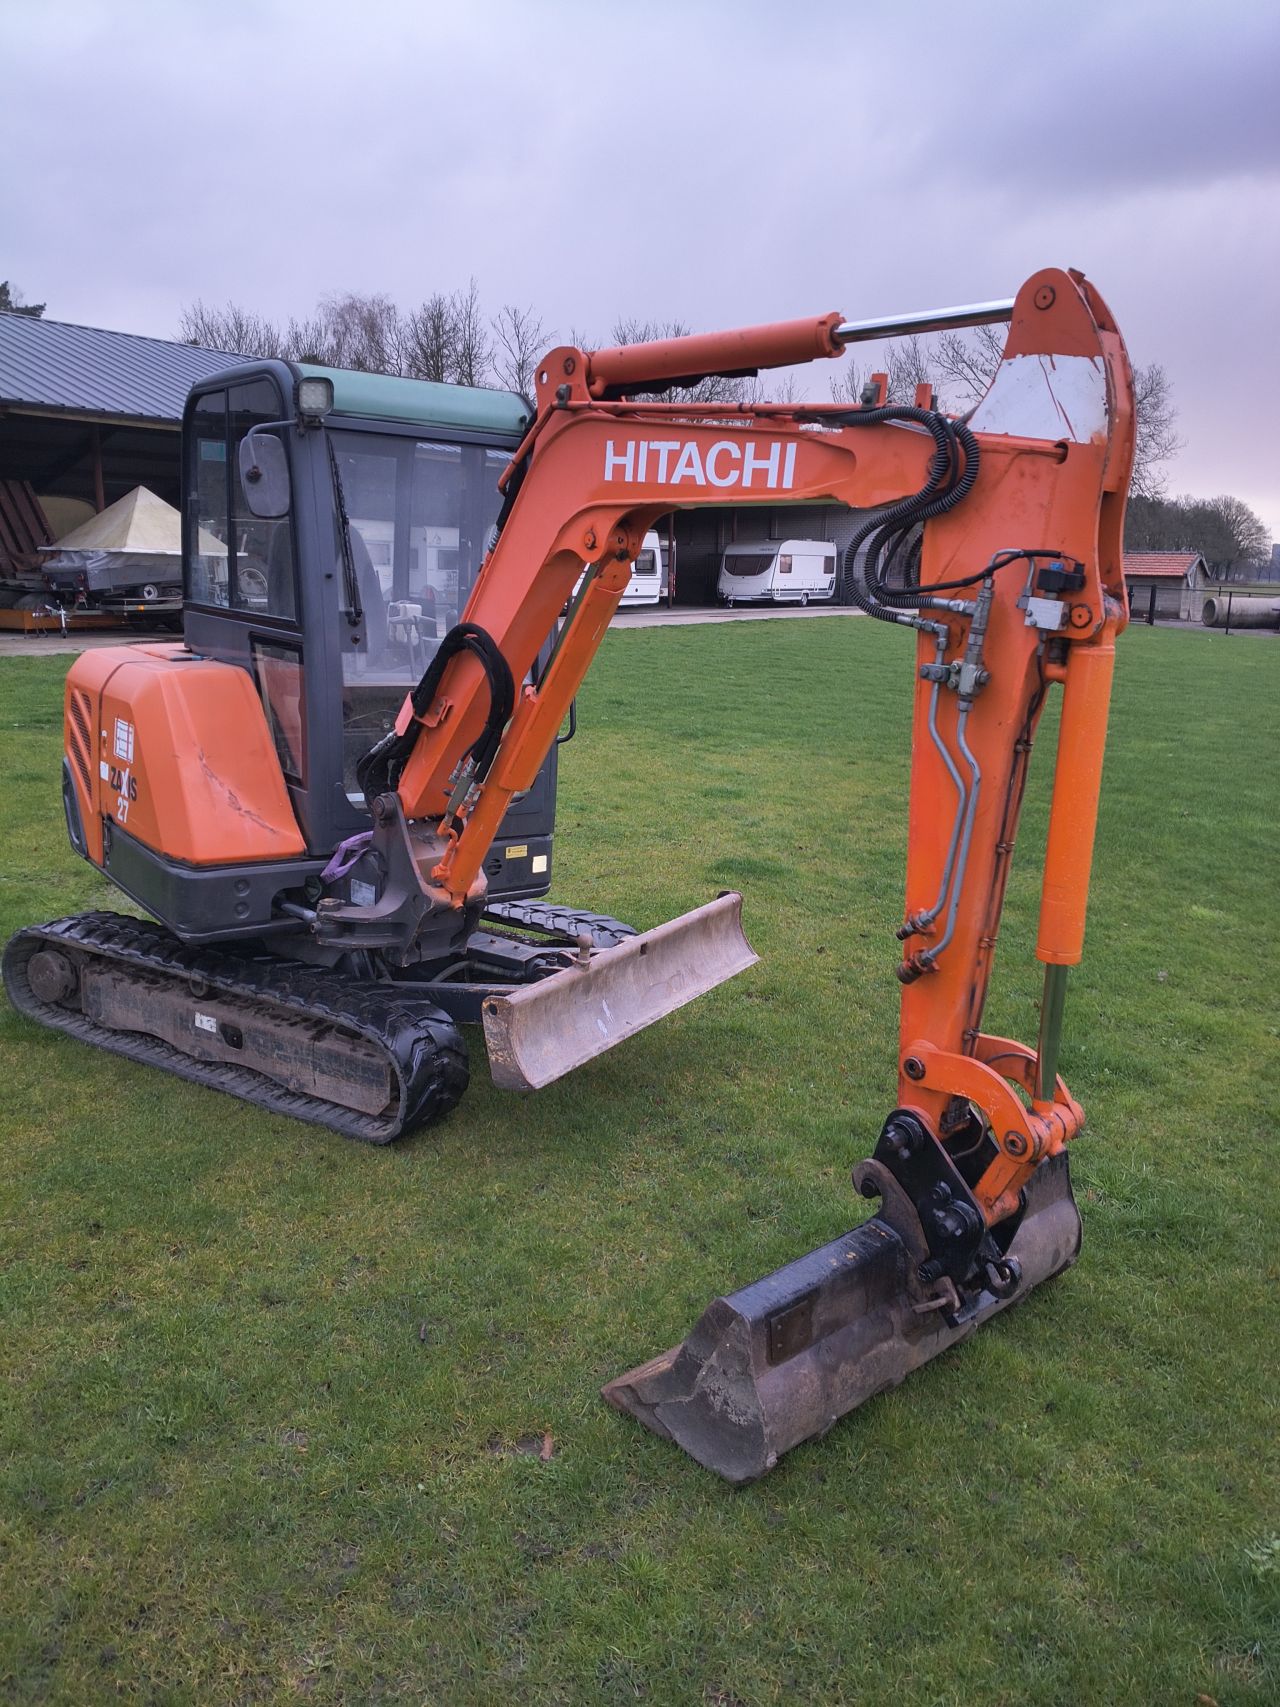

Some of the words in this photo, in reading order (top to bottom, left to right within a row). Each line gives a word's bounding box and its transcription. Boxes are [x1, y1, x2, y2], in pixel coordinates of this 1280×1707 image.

[604, 440, 797, 489] HITACHI
[111, 766, 137, 801] ZAXIS
[117, 796, 129, 823] 27
